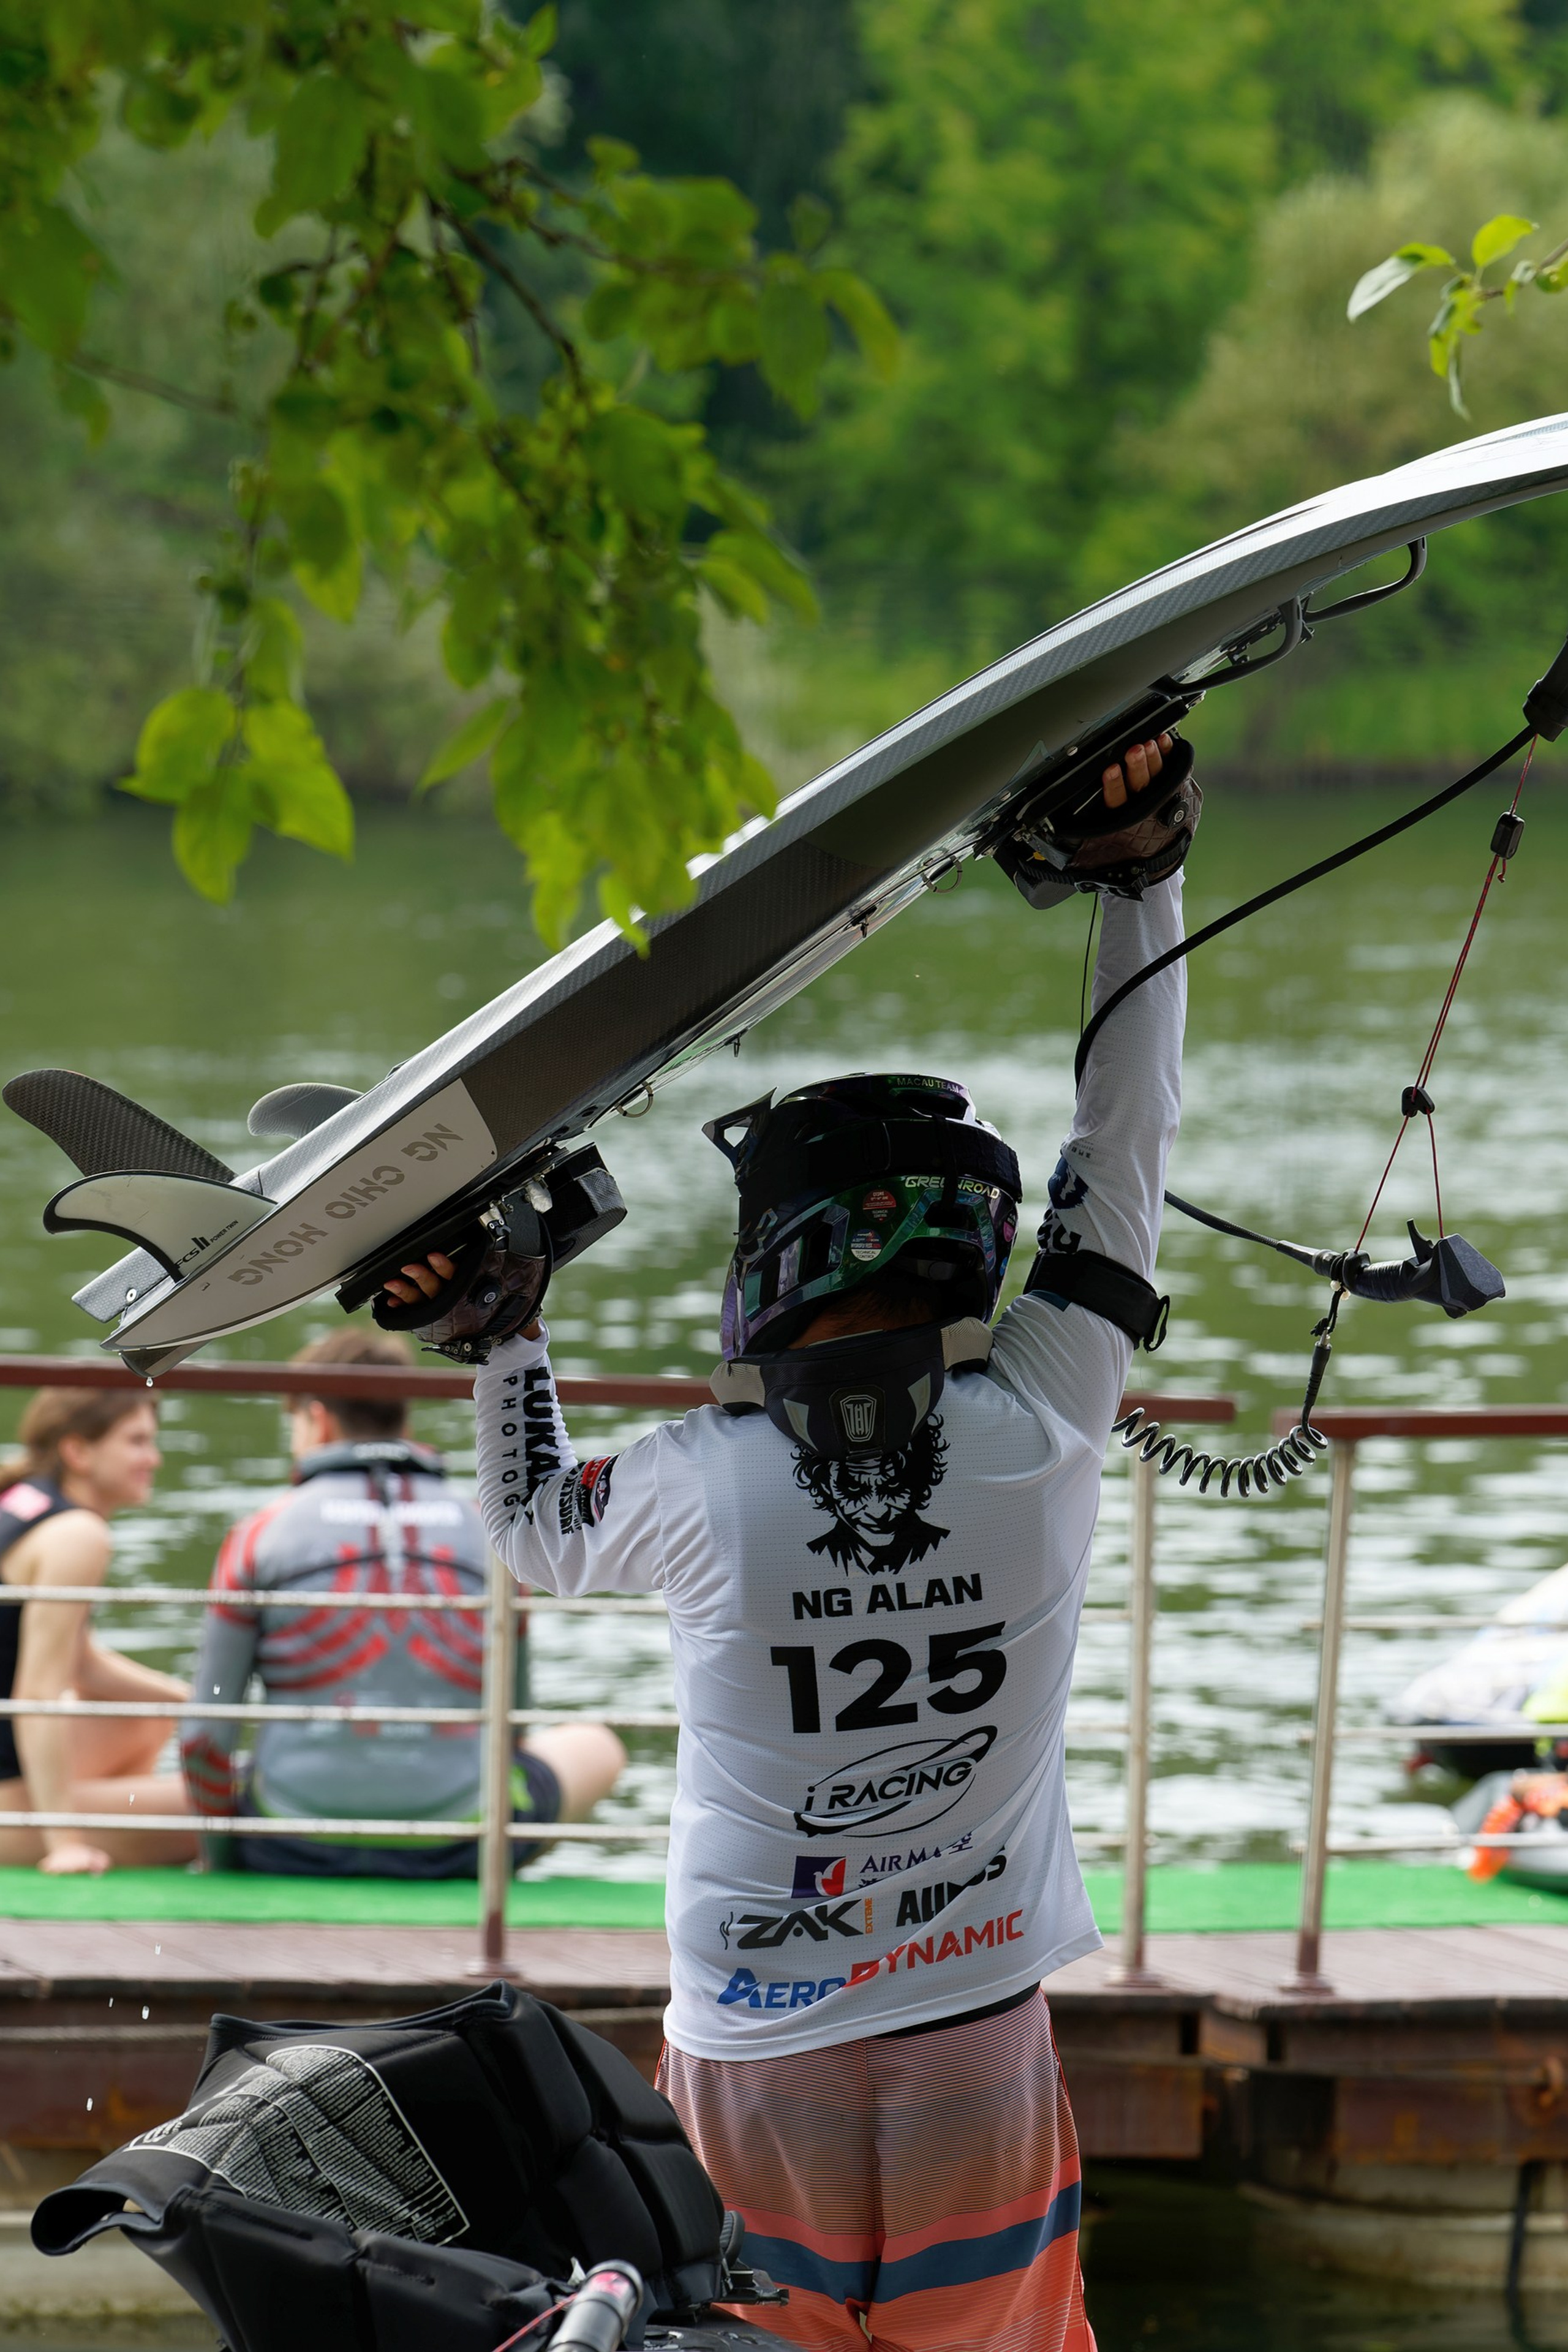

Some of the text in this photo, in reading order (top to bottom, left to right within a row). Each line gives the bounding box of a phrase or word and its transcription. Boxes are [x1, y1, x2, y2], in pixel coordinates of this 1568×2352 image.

[897, 1077, 959, 1093] MACAU TEAM
[227, 1123, 464, 1285] NG CHIO HONG
[210, 1228, 228, 1243] POWER
[225, 1219, 239, 1231] TWIN
[793, 1573, 982, 1620] NG ALAN
[770, 1621, 1007, 1733] 125
[827, 1761, 973, 1811] RACING
[737, 1898, 864, 1950] ZAK
